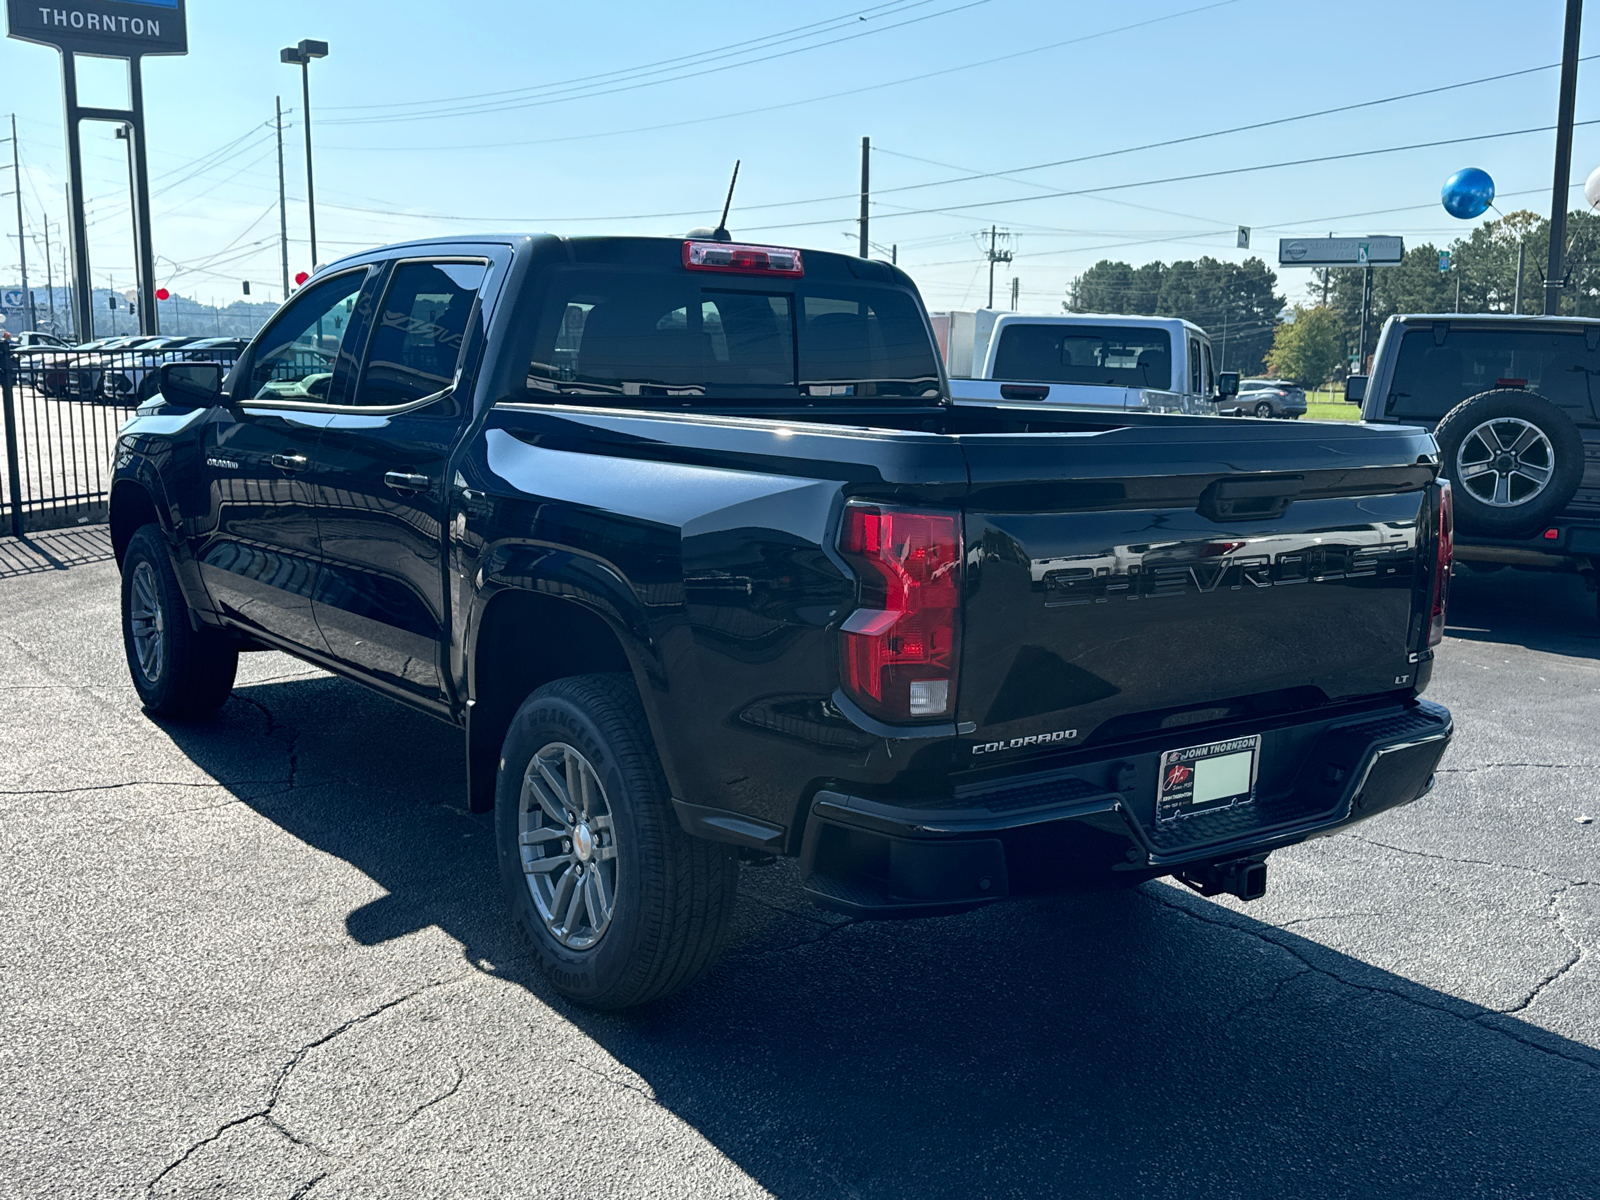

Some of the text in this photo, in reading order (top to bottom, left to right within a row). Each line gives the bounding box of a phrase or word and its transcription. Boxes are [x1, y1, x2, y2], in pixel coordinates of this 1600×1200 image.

[39, 7, 160, 37] THORNTON
[1043, 541, 1409, 608] CHEVROLET
[1395, 674, 1410, 685] LT
[528, 707, 604, 764] WRANGLER
[972, 729, 1077, 754] COLORADO
[1184, 747, 1207, 760] JOHN
[1210, 738, 1256, 754] THORNTON
[517, 918, 590, 990] GOODYEAR
